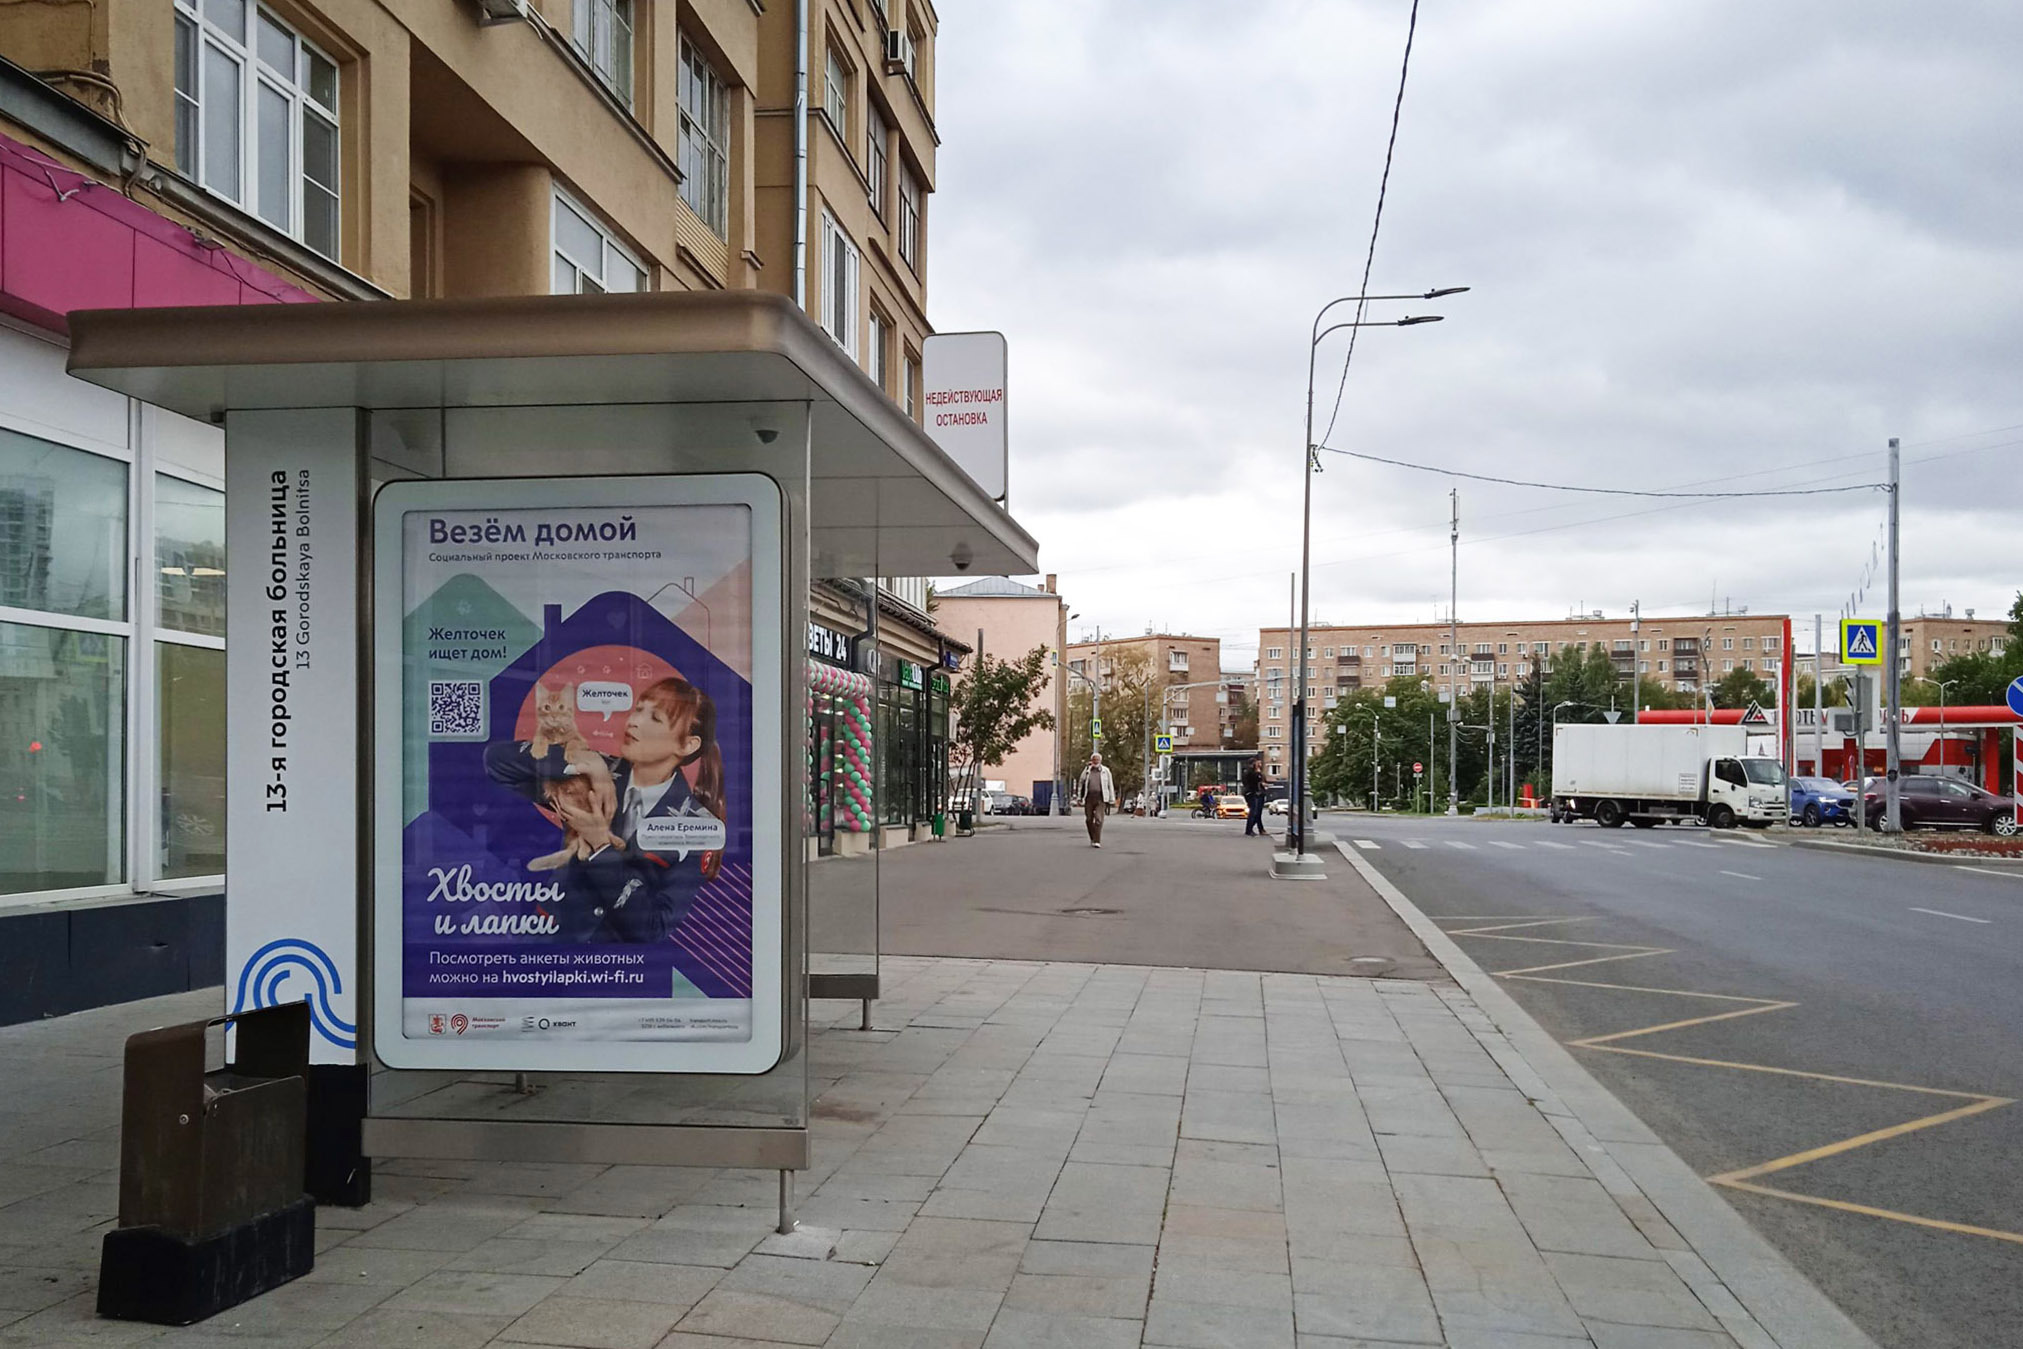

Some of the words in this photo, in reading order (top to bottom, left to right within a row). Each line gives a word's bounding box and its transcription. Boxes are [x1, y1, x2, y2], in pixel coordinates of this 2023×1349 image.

[925, 389, 1003, 407] НЕДЕЙСТВУЮЩАЯ
[936, 412, 988, 427] ОСТАНОВКА
[295, 469, 311, 538] Bolnitsa
[266, 469, 291, 602] больница
[429, 518, 527, 544] Везём
[534, 515, 637, 546] домой
[429, 551, 492, 563] Социальный
[495, 552, 530, 563] проект
[532, 550, 601, 561] Московского
[603, 551, 662, 562] транспорта
[295, 543, 314, 645] Gorodskaya
[428, 627, 506, 642] Желточек
[808, 622, 833, 657] ВЕТЫ
[836, 633, 847, 661] 24
[295, 650, 310, 670] 13
[428, 646, 467, 660] ищет
[470, 645, 507, 661] дом!
[270, 609, 292, 749] городская
[582, 689, 629, 698] Желточек
[266, 756, 288, 813] 13-я
[646, 823, 676, 832] Алена
[677, 823, 718, 833] Еремина
[427, 863, 566, 903] Хвосты
[434, 915, 458, 936] и
[460, 911, 560, 936] лапки
[429, 951, 517, 967] Посмотреть
[520, 953, 570, 966] анкеты
[573, 953, 644, 966] животных
[429, 972, 479, 984] можно
[482, 972, 499, 984] на
[502, 969, 644, 986] hvostyilapki.wi-fi.ru
